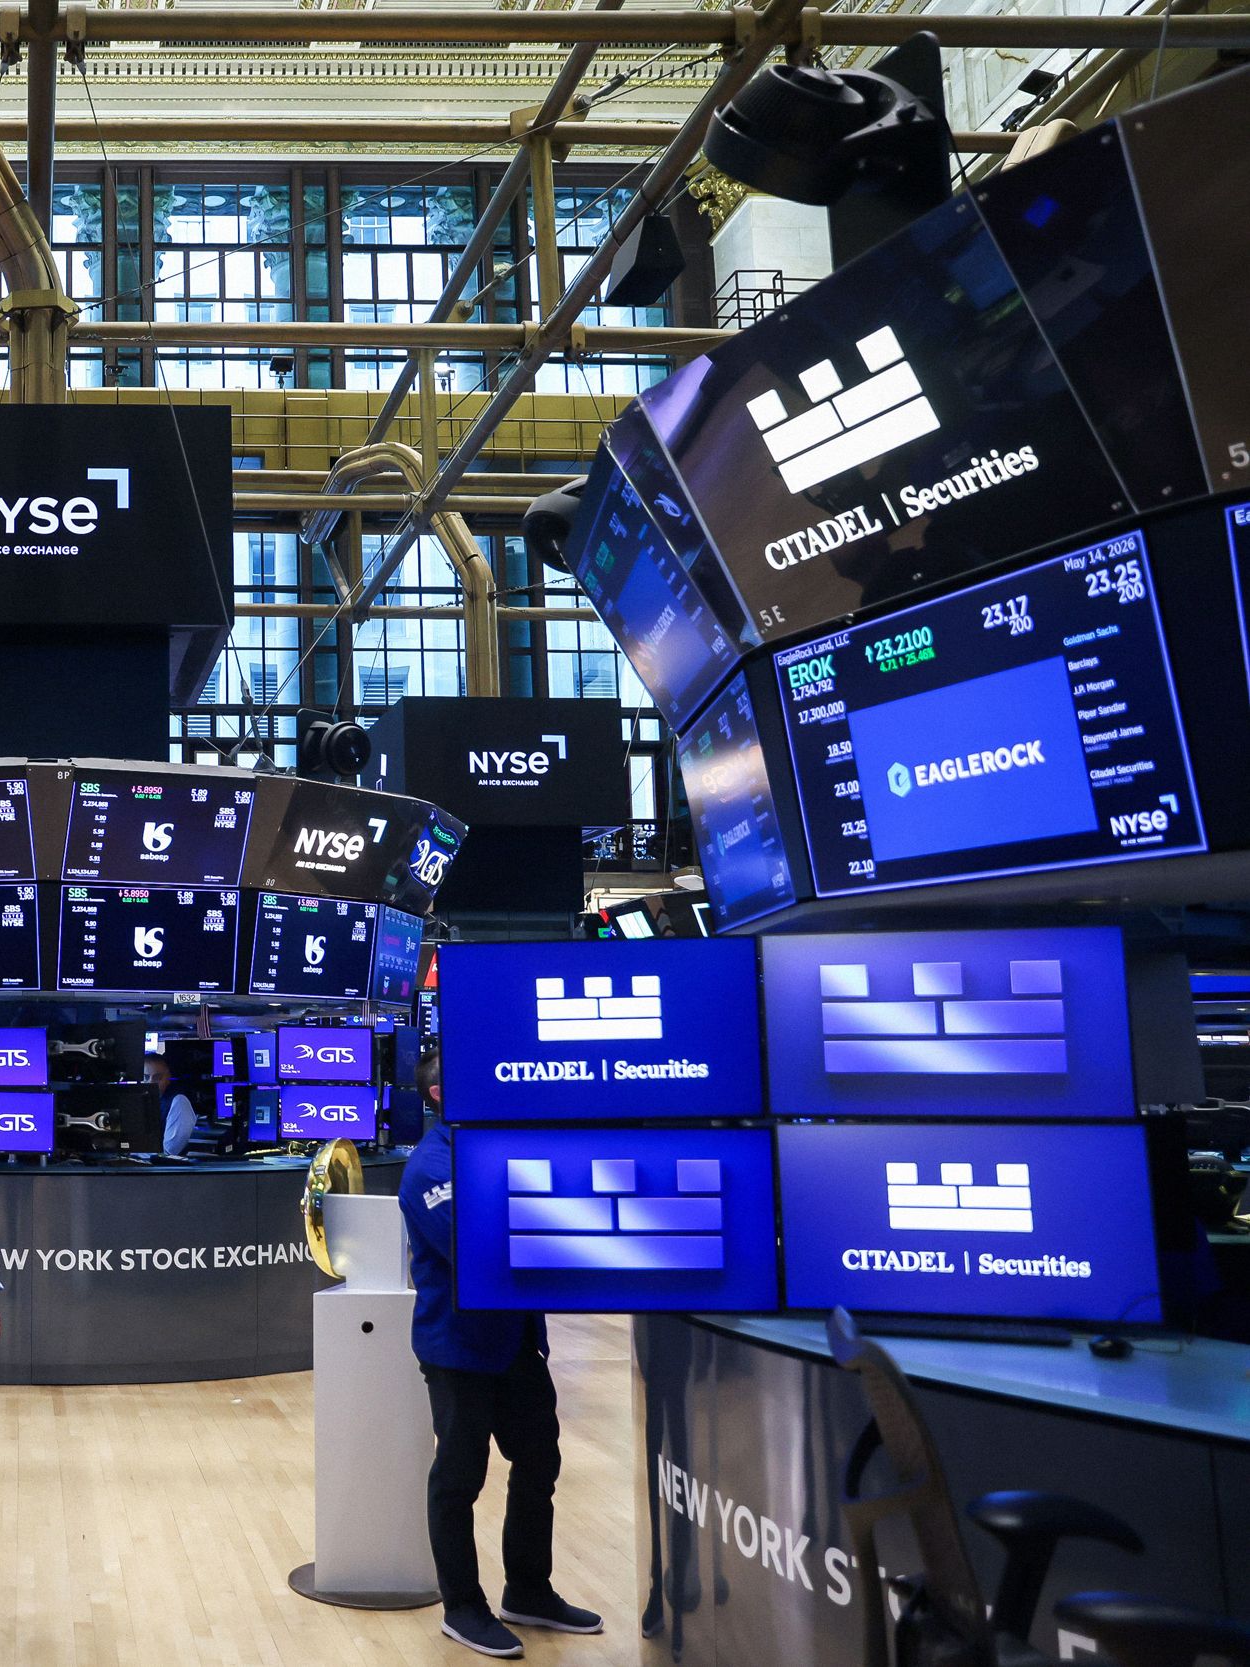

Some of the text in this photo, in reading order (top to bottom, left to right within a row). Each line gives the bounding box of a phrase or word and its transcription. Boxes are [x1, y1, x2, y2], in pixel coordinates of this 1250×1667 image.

[764, 445, 1040, 571] CITADEL Securities
[1063, 556, 1086, 572] May
[1107, 537, 1136, 558] 2026
[1085, 560, 1142, 597] 23.25
[1117, 582, 1146, 604] 200
[981, 594, 1029, 629] 23.17
[1009, 616, 1034, 636] 200
[874, 626, 933, 661] 23.2100
[1063, 625, 1119, 647] Goldman Sachs
[778, 646, 813, 666] EagleRock
[834, 633, 850, 647] LLC
[788, 654, 836, 688] EROK
[1068, 657, 1099, 672] Barclays
[792, 678, 834, 701] 1,734,792
[1086, 679, 1116, 692] Morgan
[798, 700, 845, 724] 17,300,000
[1097, 702, 1127, 715] Sandler
[1082, 725, 1144, 745] Raymond James
[827, 740, 852, 758] 18.50
[914, 740, 1046, 787] EAGLEROCK
[1090, 761, 1154, 779] Citadel Securities
[6, 782, 24, 790] 5.90
[80, 783, 100, 793] SBS
[136, 786, 163, 794] 5.8950
[191, 789, 208, 797] 5.89
[834, 780, 859, 797] 23.00
[235, 791, 251, 799] 5.90
[219, 807, 236, 815] SBS
[214, 821, 236, 829] NYSE
[841, 820, 867, 837] 23.25
[139, 853, 169, 862] sabesp
[849, 859, 874, 876] 22.10
[17, 887, 34, 895] 5.90
[68, 888, 88, 898] SBS
[123, 890, 149, 898] 5.8950
[2, 919, 24, 927] NYSE
[203, 924, 225, 932] NYSE
[133, 959, 162, 968] sabesp
[494, 1059, 709, 1082] CITADEL Securities
[36, 1248, 114, 1272] YORK
[120, 1247, 208, 1271] STOCK
[213, 1241, 314, 1268] EXCHAN
[841, 1248, 1092, 1278] CITADEL Securities
[658, 1454, 708, 1529] NEW
[713, 1490, 814, 1592] YORK
